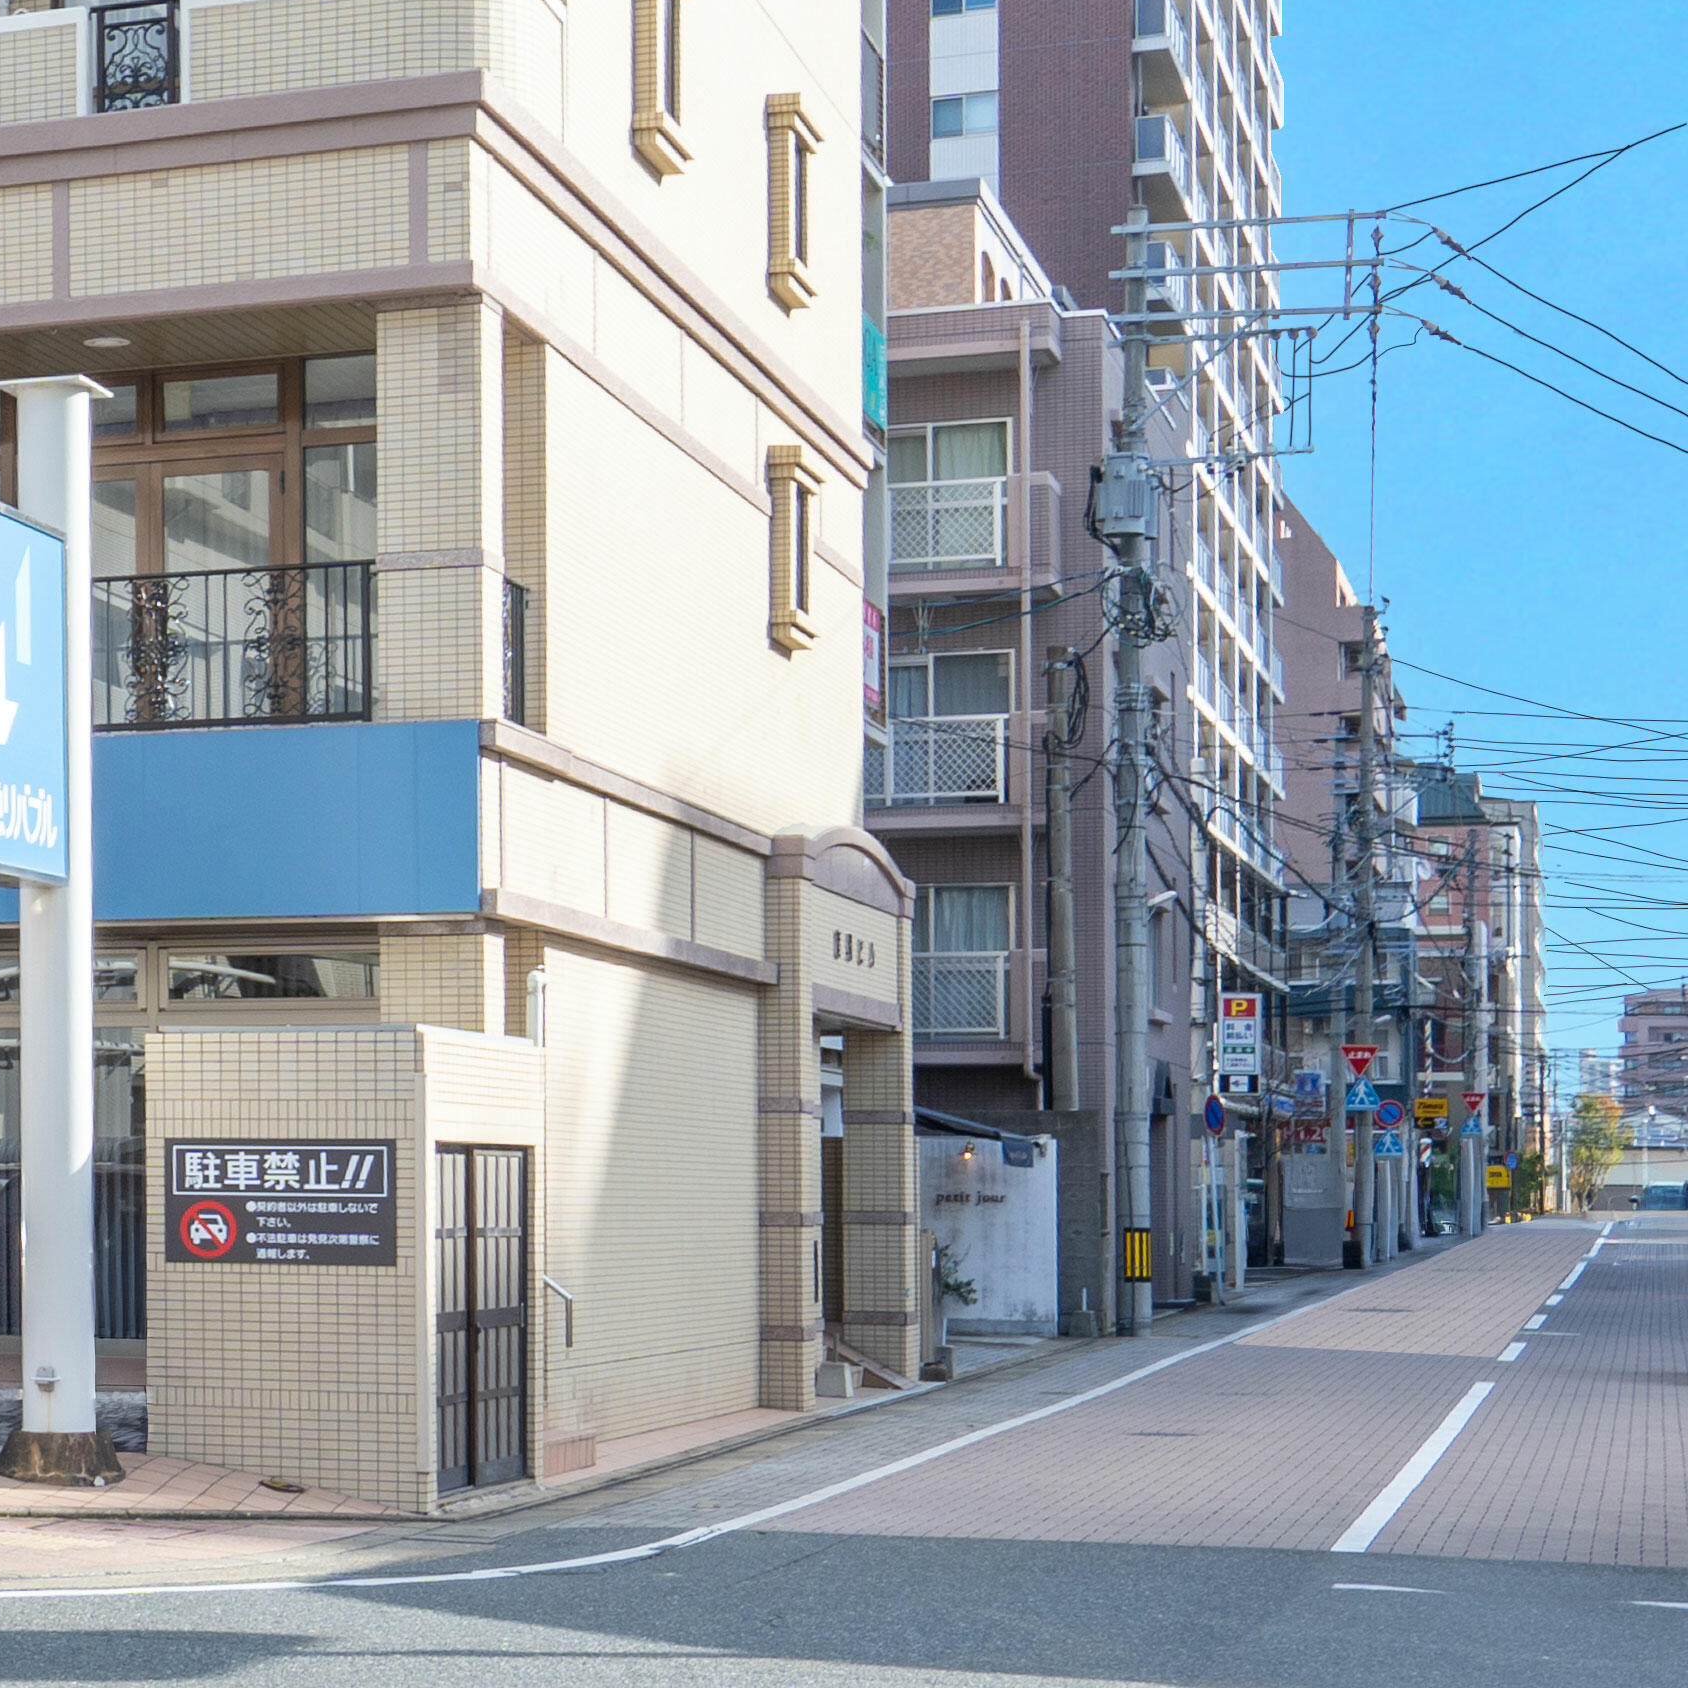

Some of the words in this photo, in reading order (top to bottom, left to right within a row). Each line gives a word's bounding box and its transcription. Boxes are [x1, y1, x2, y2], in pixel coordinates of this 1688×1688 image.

[1231, 1000, 1248, 1015] P
[935, 1191, 971, 1206] petit
[976, 1191, 1006, 1206] jour
